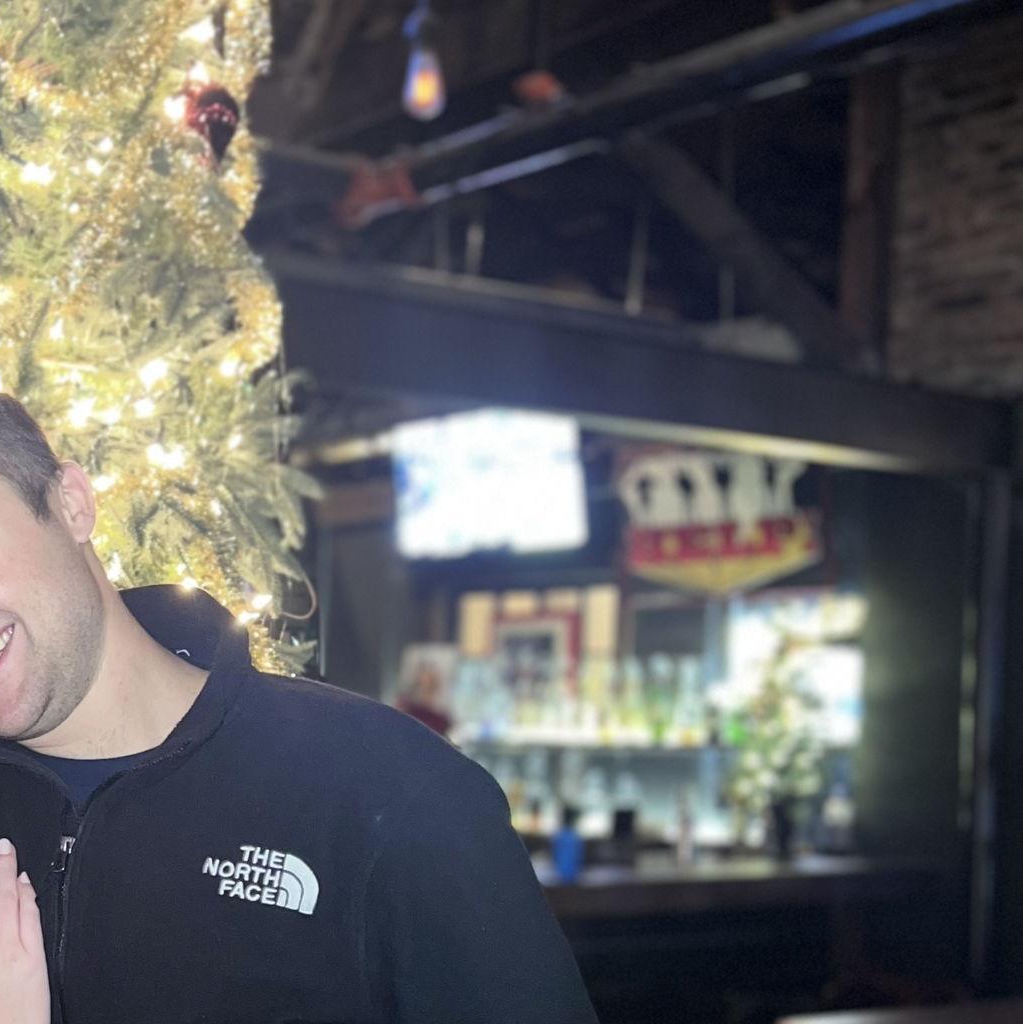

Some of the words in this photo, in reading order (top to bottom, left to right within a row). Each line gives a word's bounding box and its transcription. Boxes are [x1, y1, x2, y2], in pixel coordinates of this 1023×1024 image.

[240, 845, 285, 869] THE
[202, 857, 281, 888] NORTH
[218, 879, 277, 905] FACE
